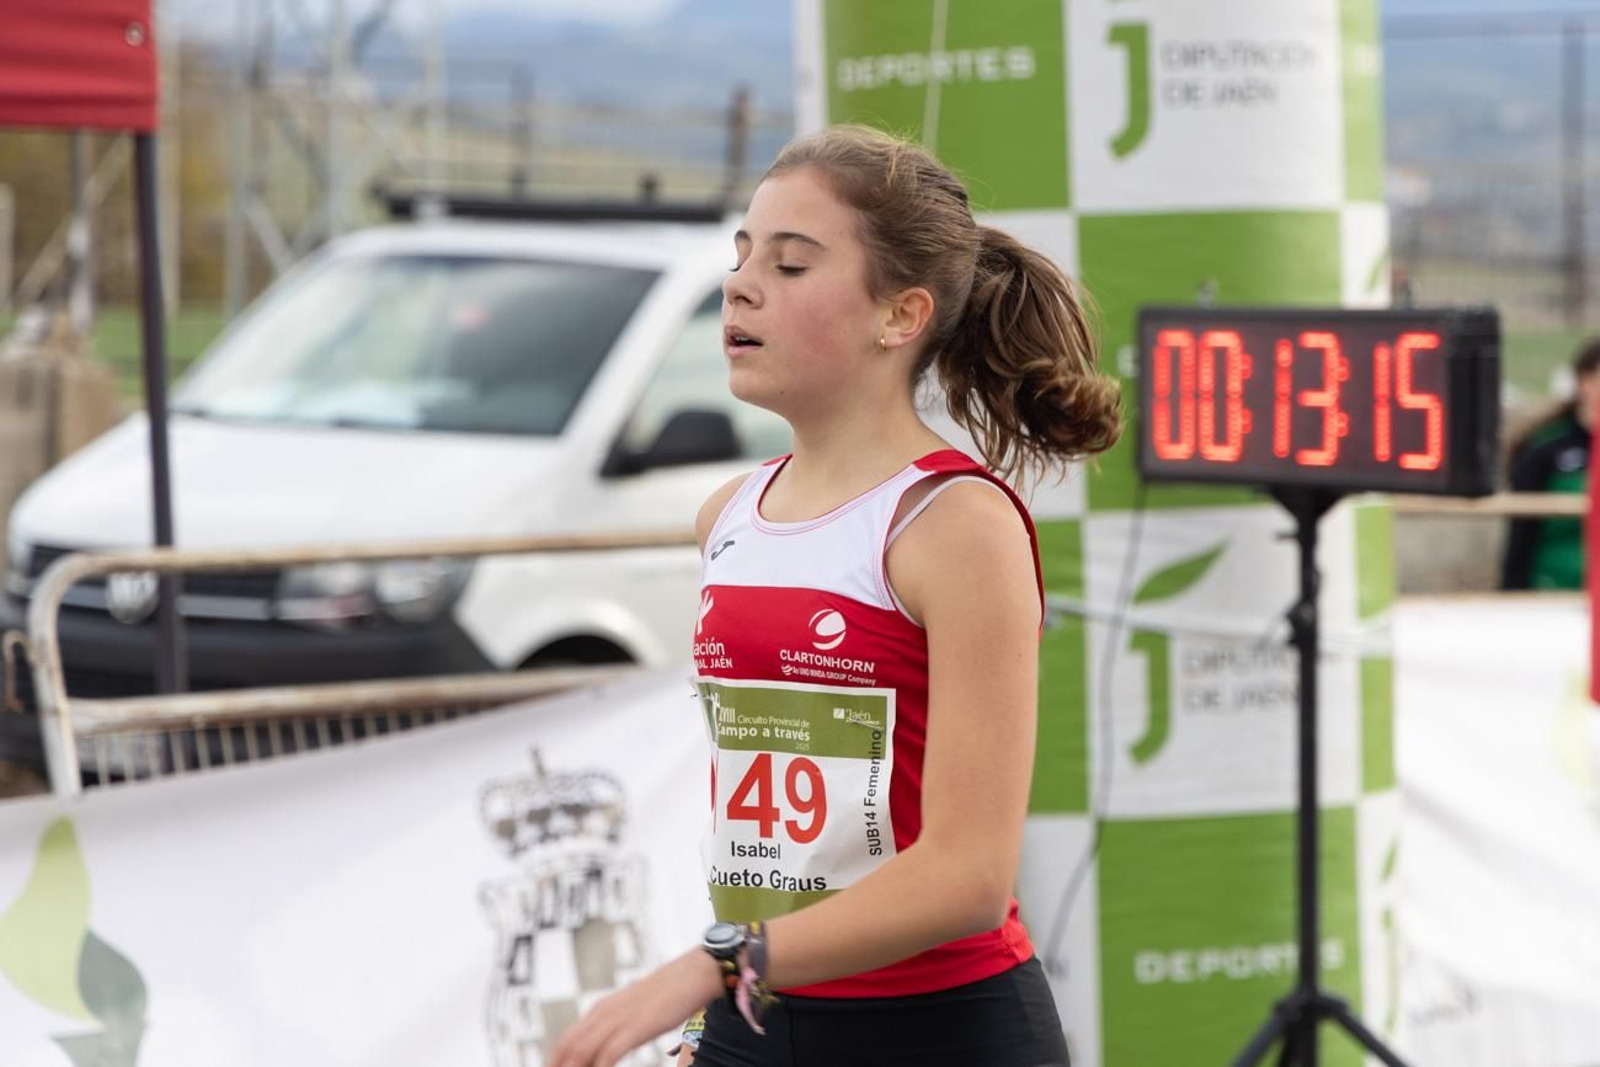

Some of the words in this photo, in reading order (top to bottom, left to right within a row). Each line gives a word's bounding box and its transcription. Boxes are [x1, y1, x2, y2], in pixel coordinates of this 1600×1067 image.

[837, 46, 1036, 91] DEPORTES
[693, 637, 725, 656] ación
[780, 649, 875, 673] CLARTONHORN
[737, 715, 768, 725] Circuito
[769, 716, 800, 727] Provincial
[800, 719, 810, 728] de
[762, 729, 770, 738] a
[774, 726, 810, 741] través
[864, 730, 882, 807] Femenino
[711, 753, 827, 844] 49
[864, 812, 882, 856] SUB14
[731, 841, 780, 859] Isabel
[770, 870, 827, 892] Graus
[1134, 938, 1346, 985] DEPORTS
